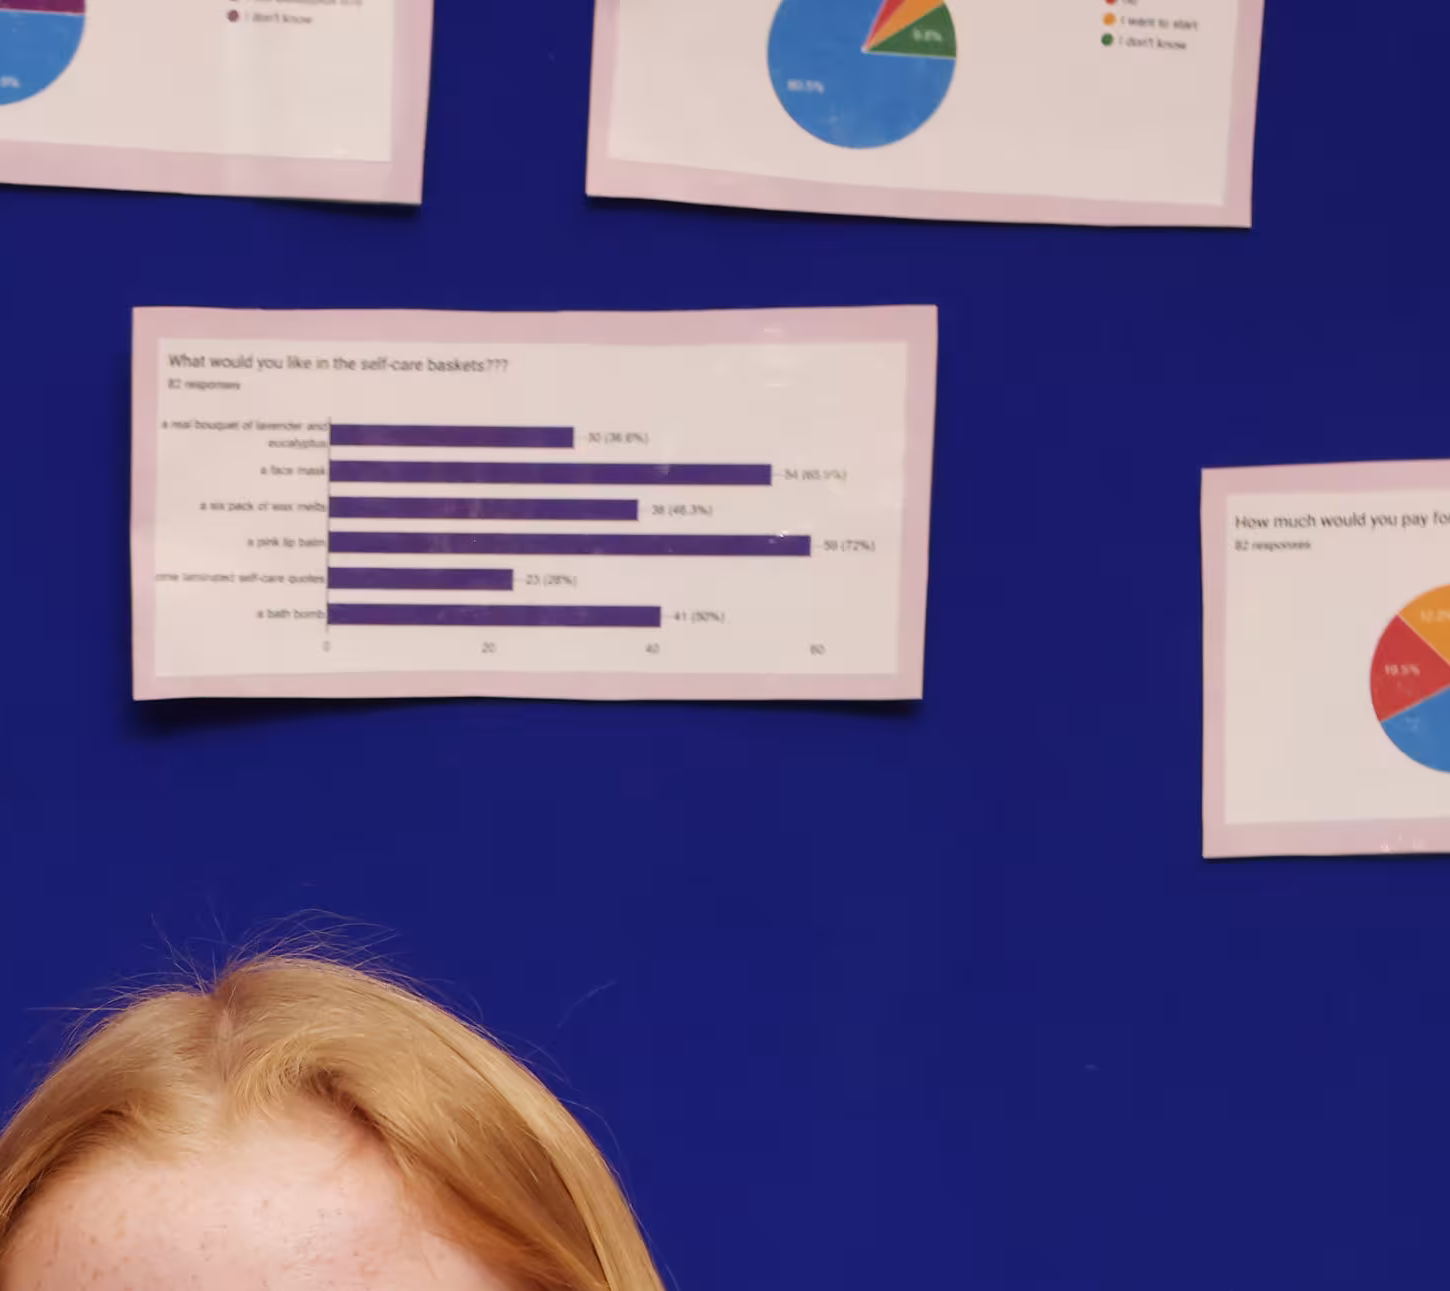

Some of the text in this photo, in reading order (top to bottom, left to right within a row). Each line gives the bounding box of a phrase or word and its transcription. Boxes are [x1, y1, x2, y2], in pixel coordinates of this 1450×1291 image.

[168, 354, 509, 373] What would you like in the self-care baskets???
[1235, 515, 1270, 530] How
[1273, 513, 1317, 529] much
[1320, 511, 1367, 527] would
[1370, 514, 1399, 531] you
[1402, 513, 1429, 530] pay
